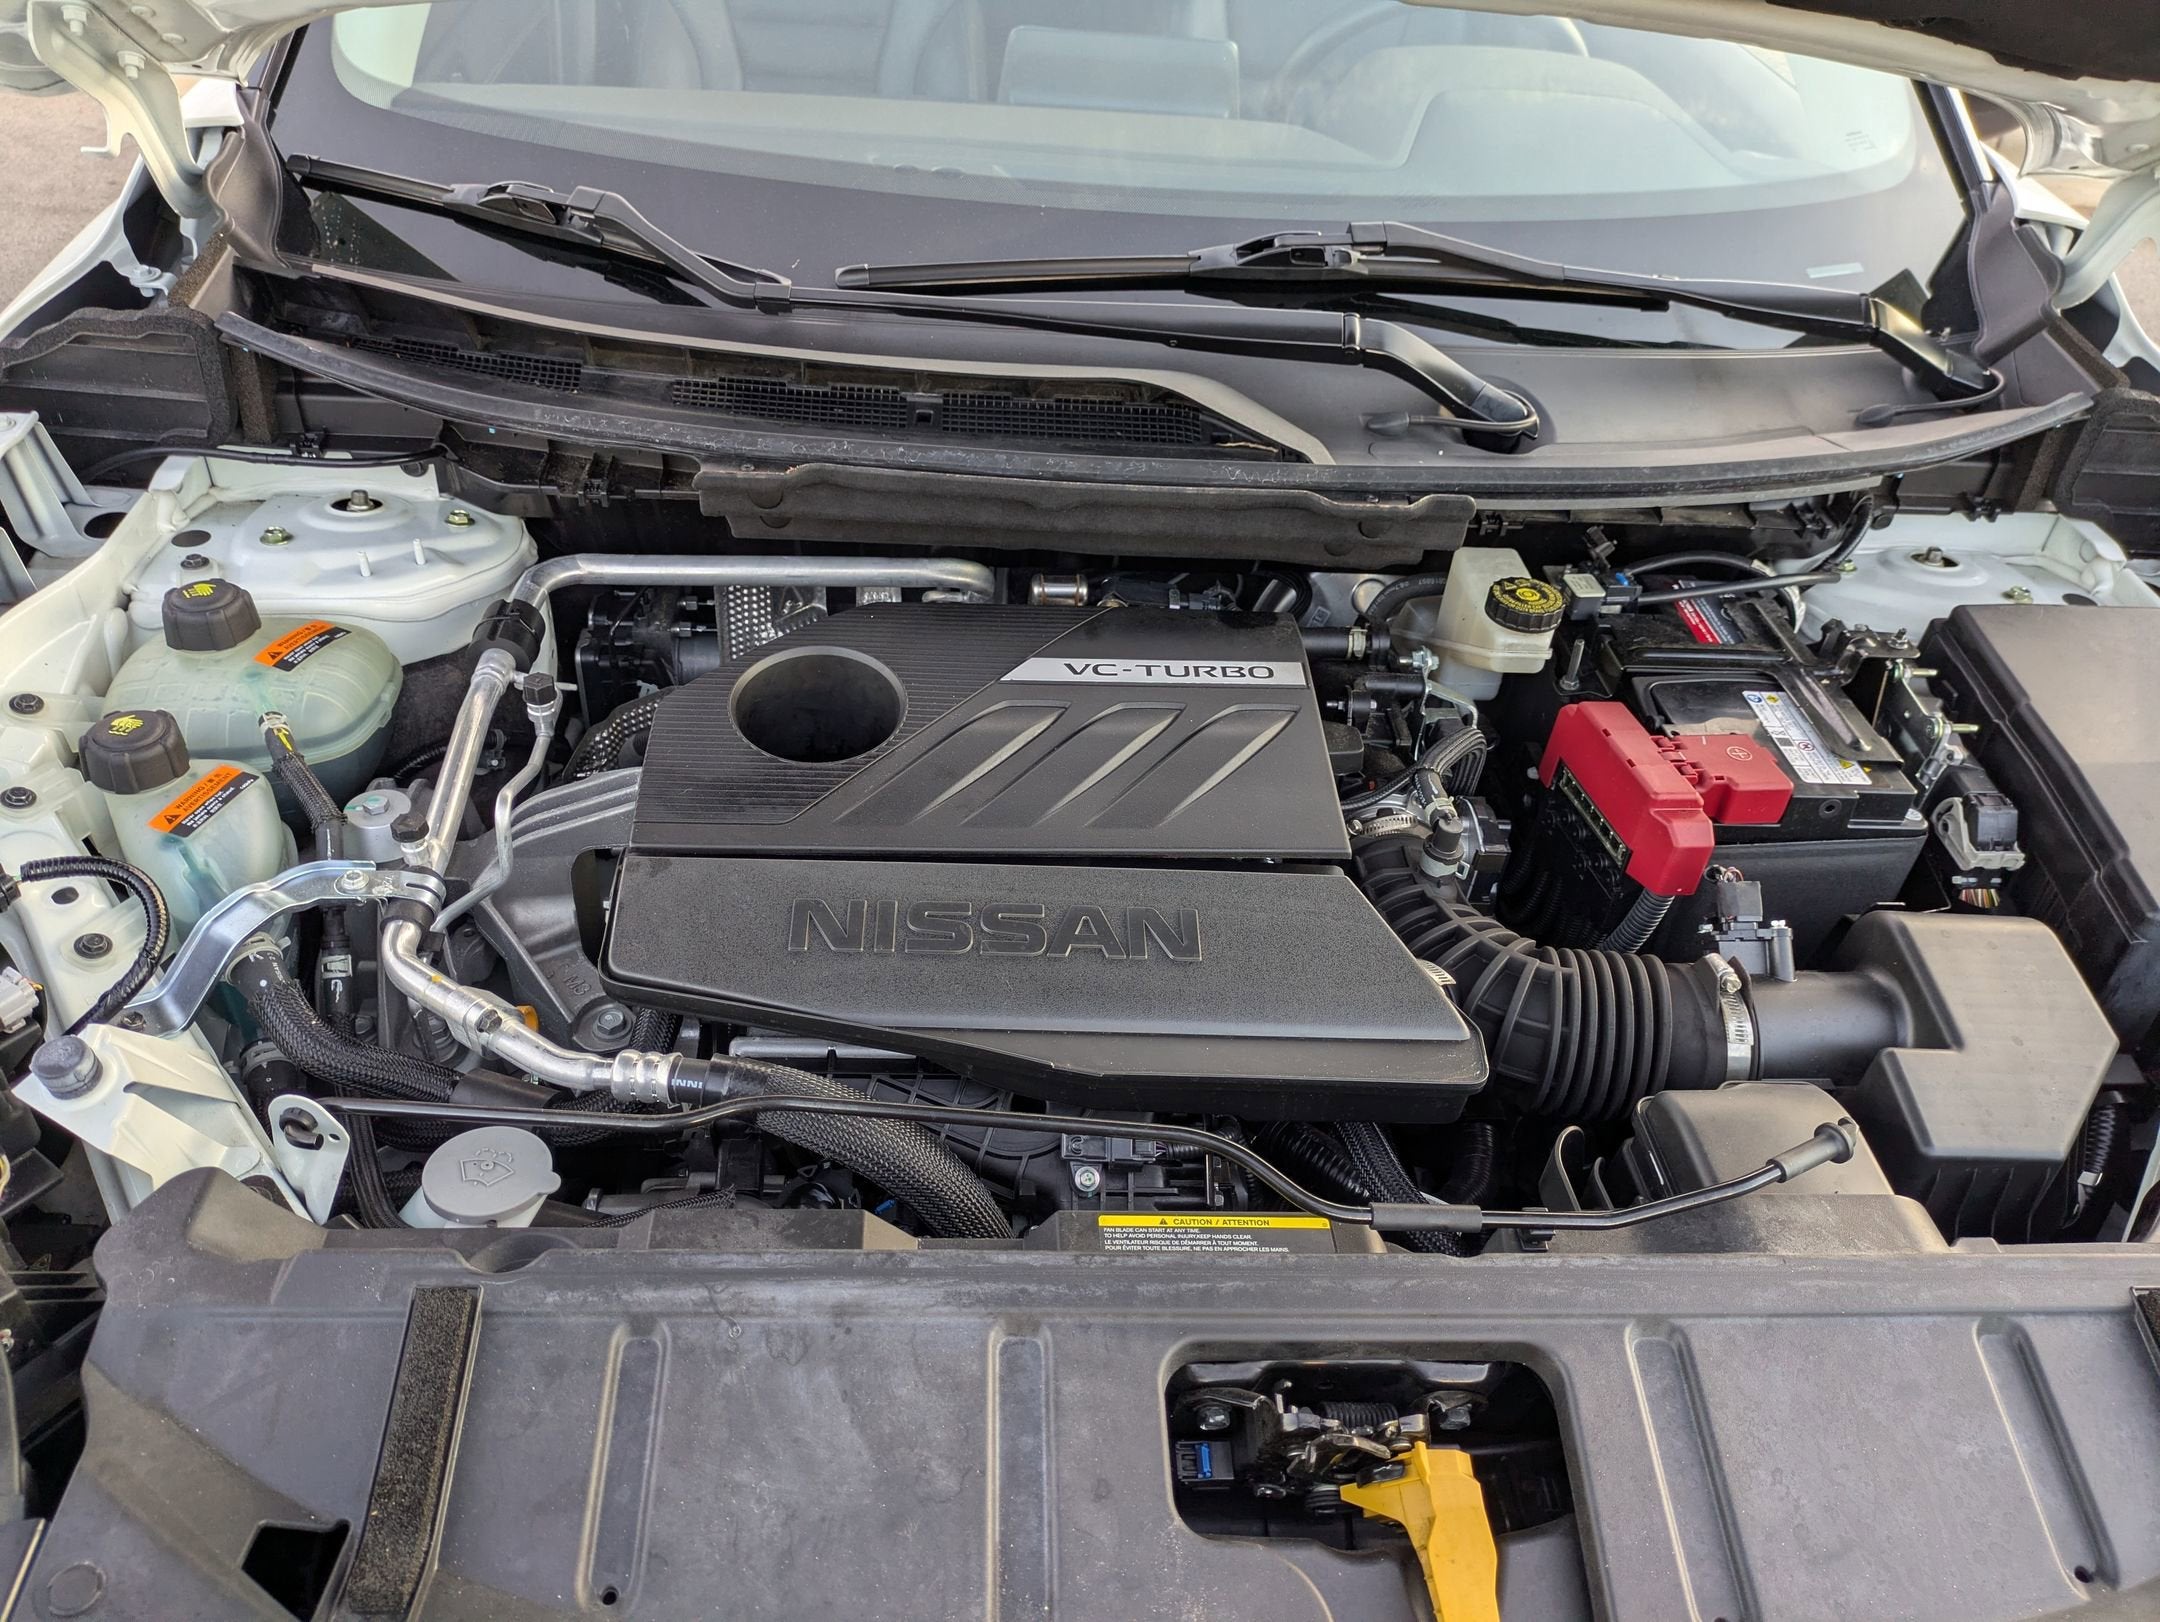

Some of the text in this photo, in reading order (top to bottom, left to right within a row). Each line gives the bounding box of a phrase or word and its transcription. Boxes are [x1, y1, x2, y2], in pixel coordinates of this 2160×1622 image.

[1063, 662, 1275, 680] VC-TURBO
[176, 786, 205, 809] WARNING
[788, 899, 1202, 962] NISSAN
[1173, 1218, 1213, 1226] CAUTION
[1222, 1219, 1270, 1227] ATTENTION
